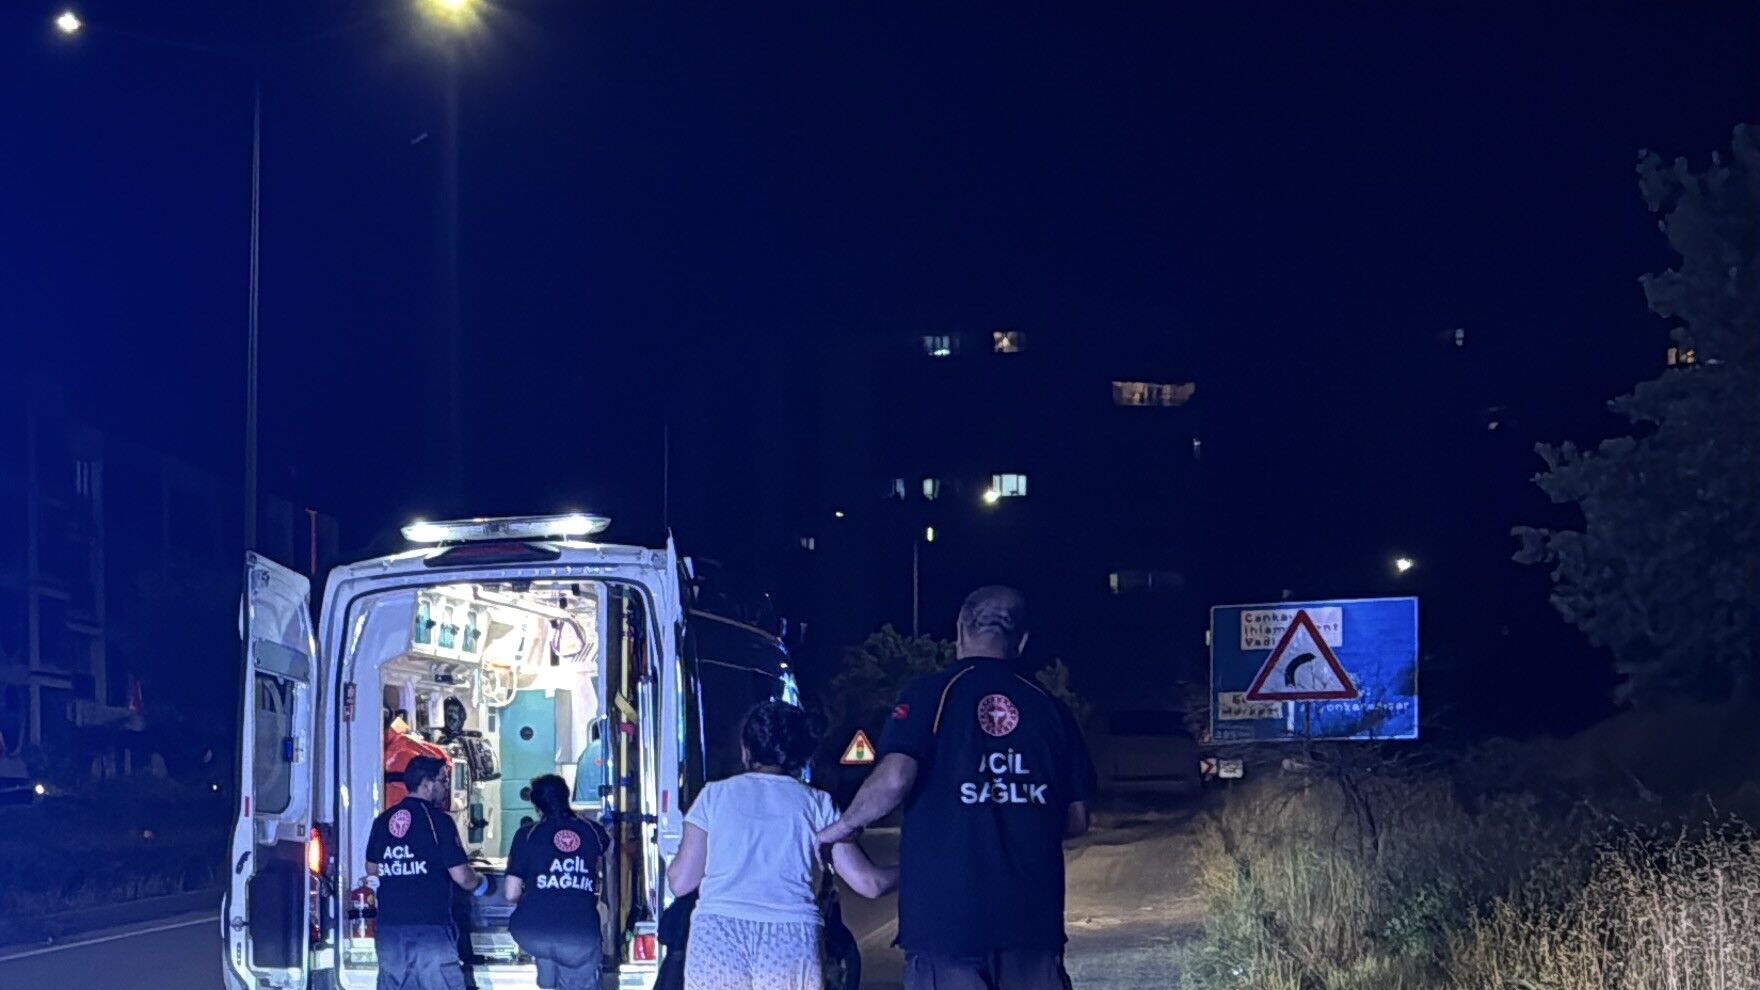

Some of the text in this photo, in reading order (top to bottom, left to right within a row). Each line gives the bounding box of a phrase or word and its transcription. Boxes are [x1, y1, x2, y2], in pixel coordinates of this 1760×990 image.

[383, 844, 415, 860] ACL
[377, 860, 428, 877] SAĞLIK
[549, 855, 589, 873] ACİL
[536, 872, 594, 892] SAĞLIK
